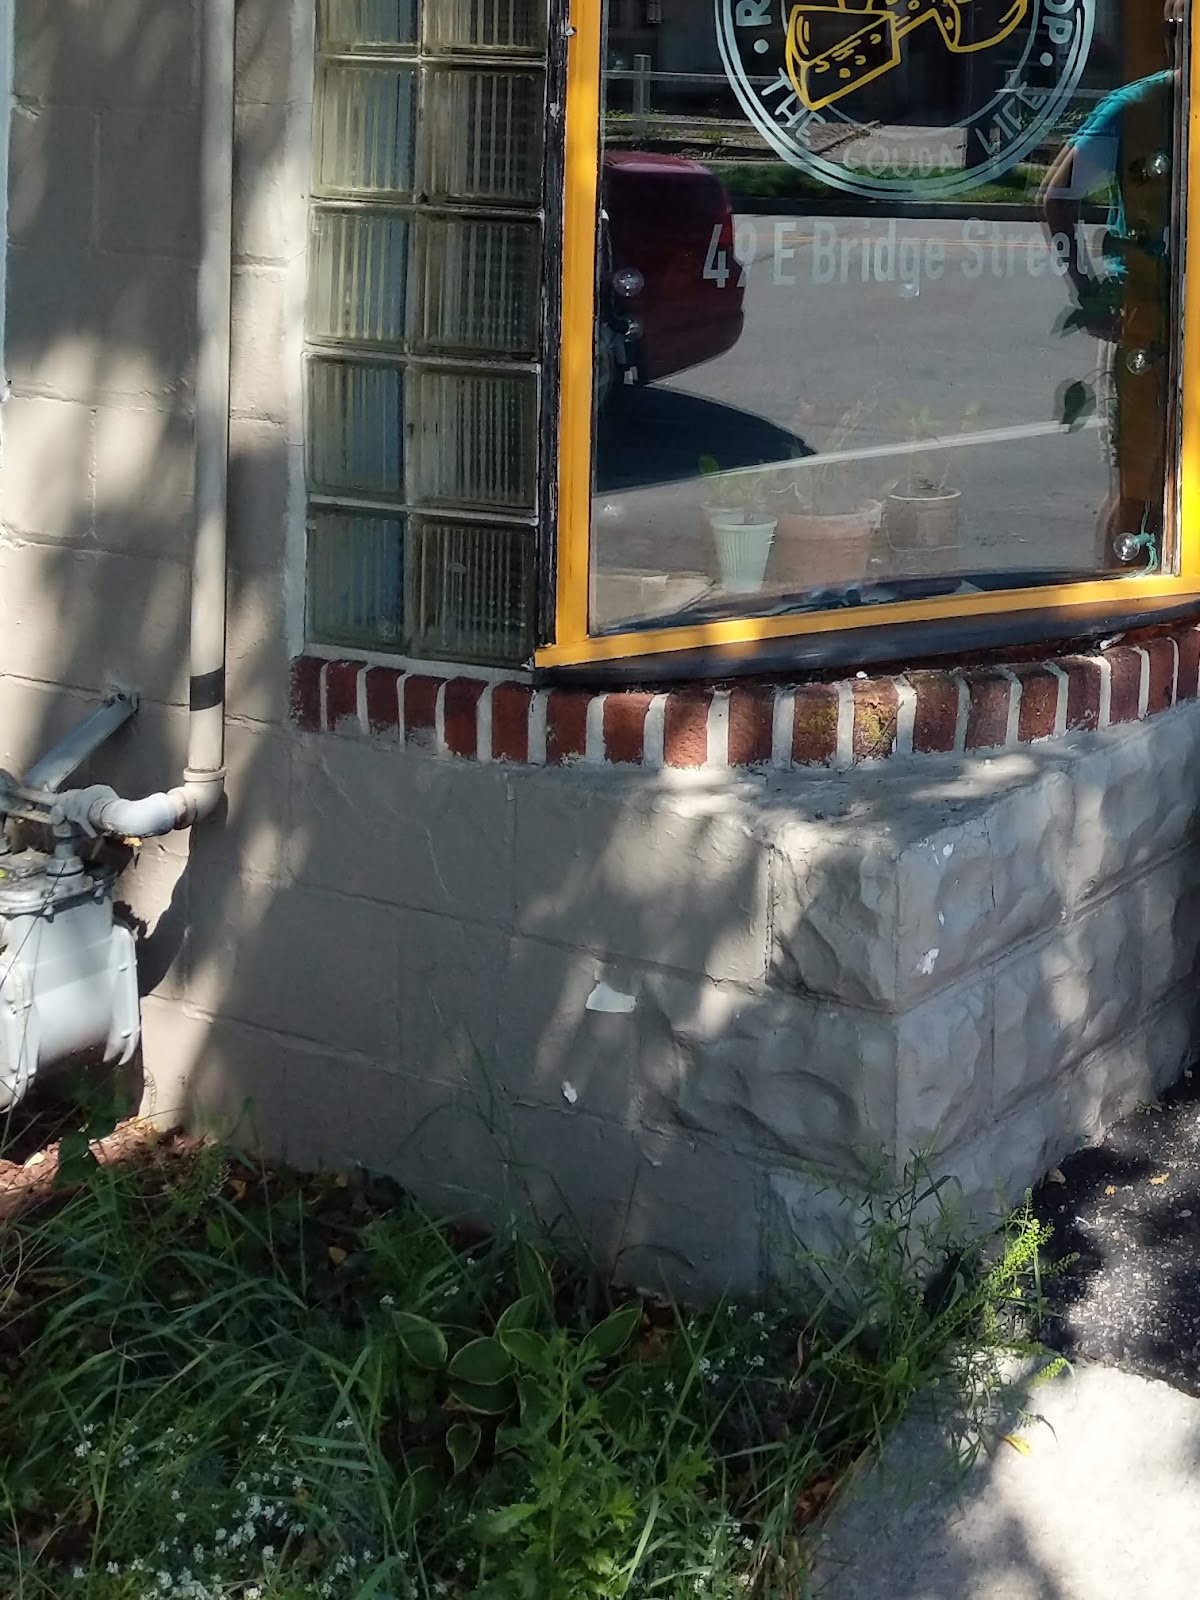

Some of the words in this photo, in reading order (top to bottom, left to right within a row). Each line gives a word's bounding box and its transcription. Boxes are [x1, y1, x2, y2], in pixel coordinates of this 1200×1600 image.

[761, 66, 827, 146] THE
[843, 139, 956, 178] GOUDA
[975, 81, 1047, 155] LIFE
[702, 222, 758, 288] 49
[773, 222, 798, 286] E
[812, 218, 946, 296] Bridge
[961, 217, 1088, 279] Street
